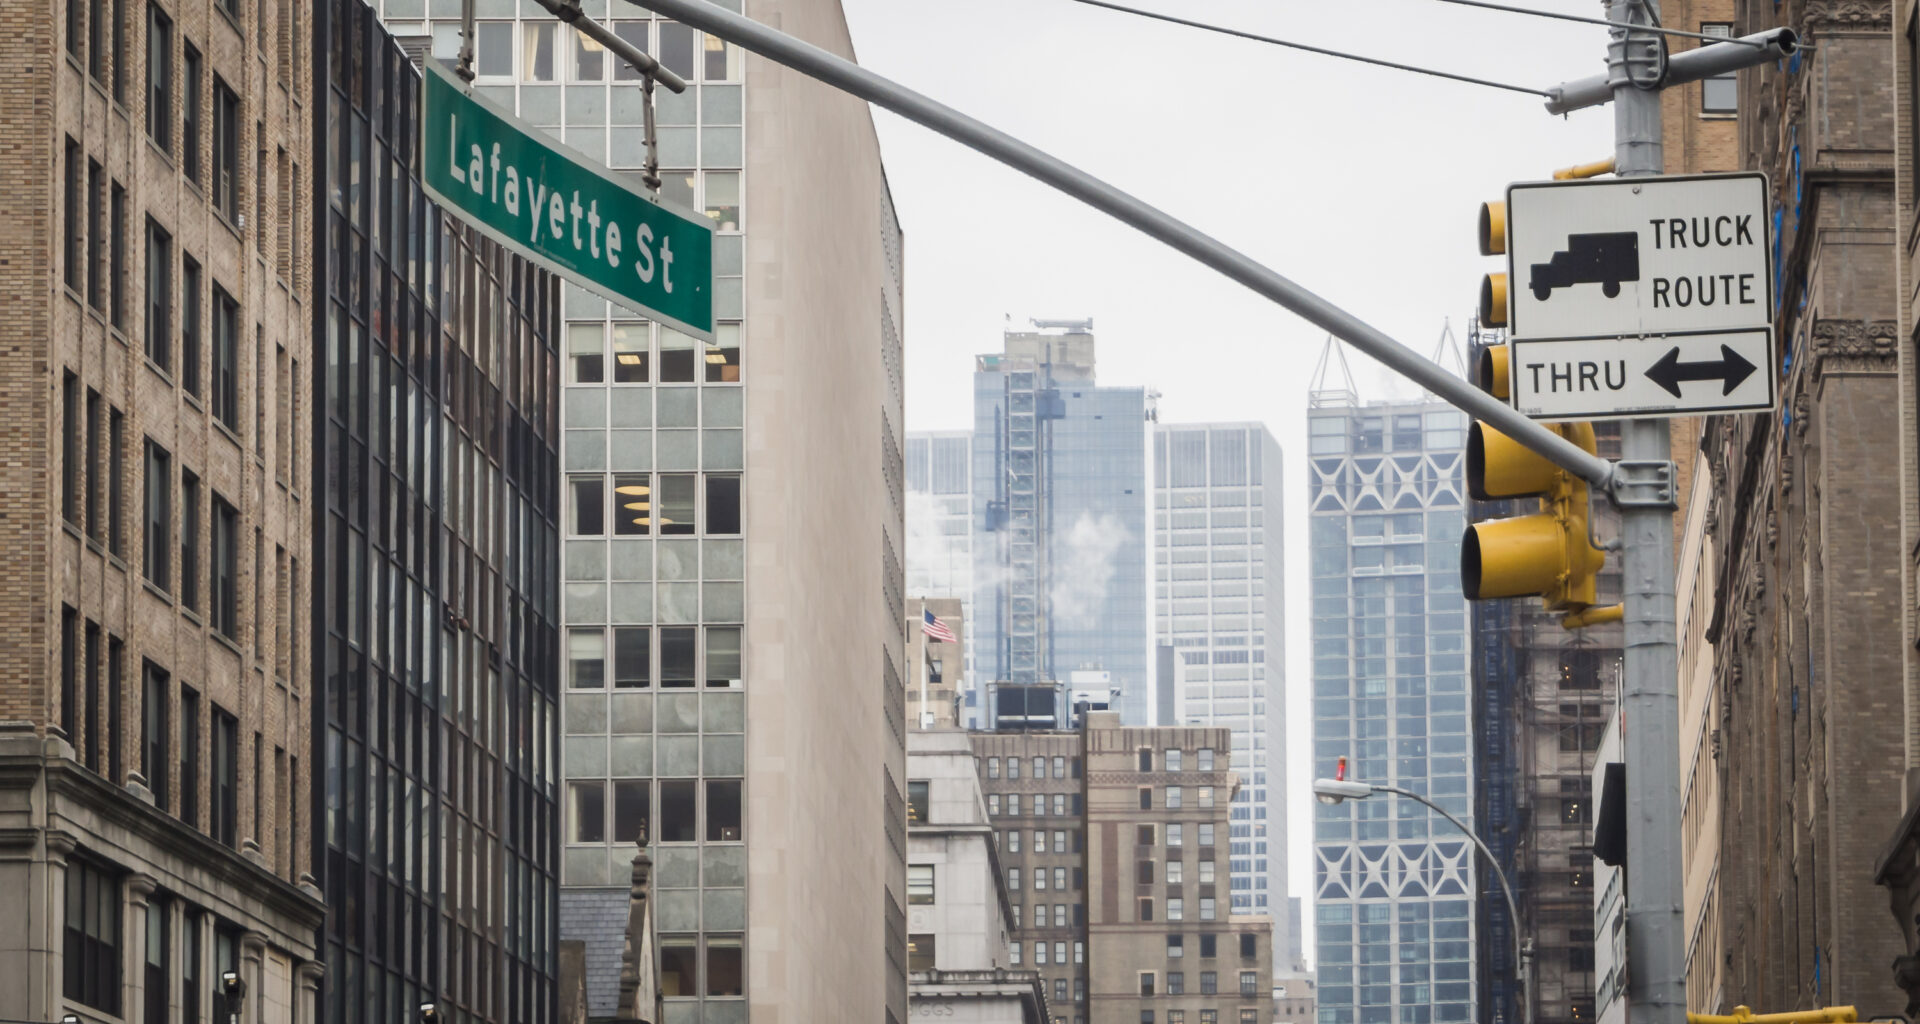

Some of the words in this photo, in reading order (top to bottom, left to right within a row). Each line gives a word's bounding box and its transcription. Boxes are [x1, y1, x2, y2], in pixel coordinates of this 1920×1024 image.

[450, 113, 622, 268] Lafayette
[635, 222, 674, 294] St
[1649, 214, 1754, 250] TRUCK
[1652, 273, 1756, 309] ROUTE
[1526, 359, 1627, 394] THRU
